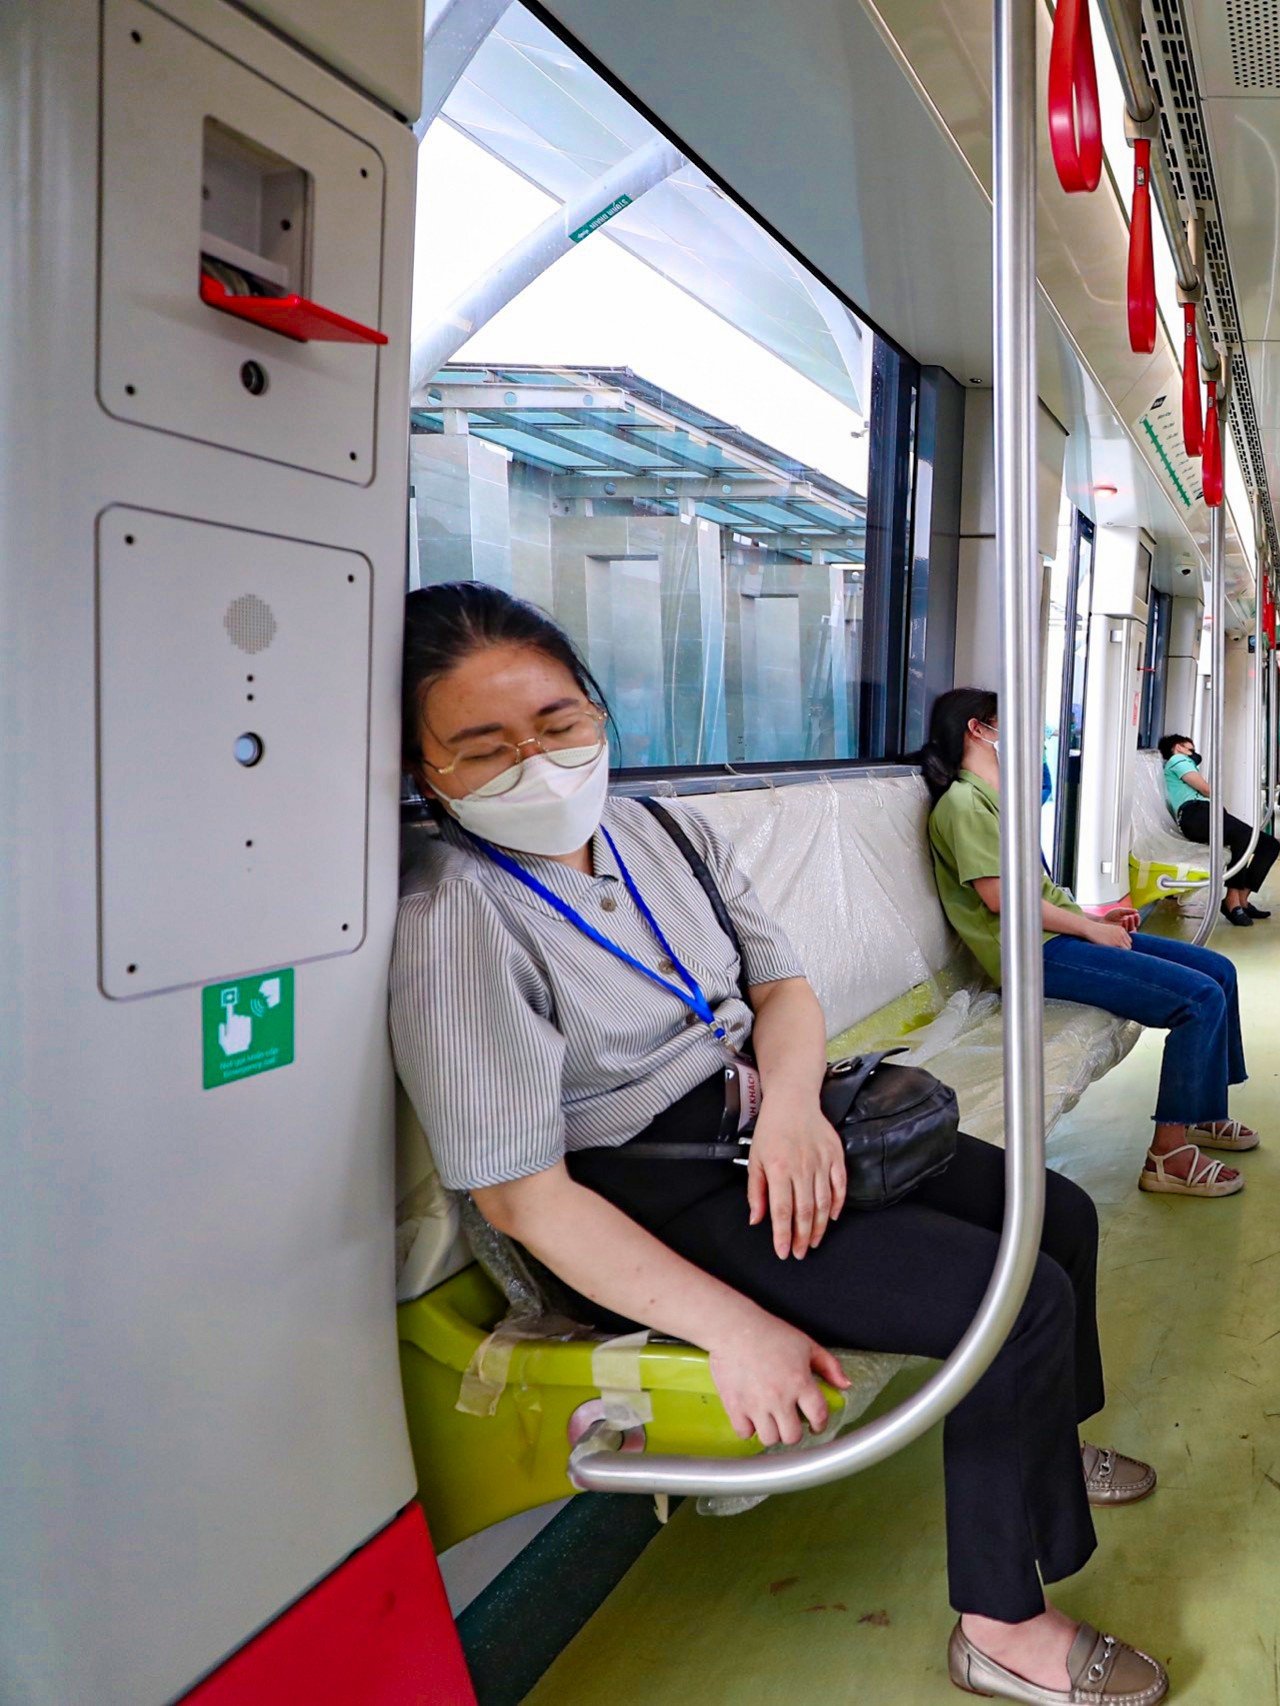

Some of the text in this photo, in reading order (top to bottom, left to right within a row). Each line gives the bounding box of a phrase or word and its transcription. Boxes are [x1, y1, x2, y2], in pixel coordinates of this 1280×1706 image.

[589, 199, 629, 229] STORM DRAIN
[747, 1072, 757, 1104] KHÁCH
